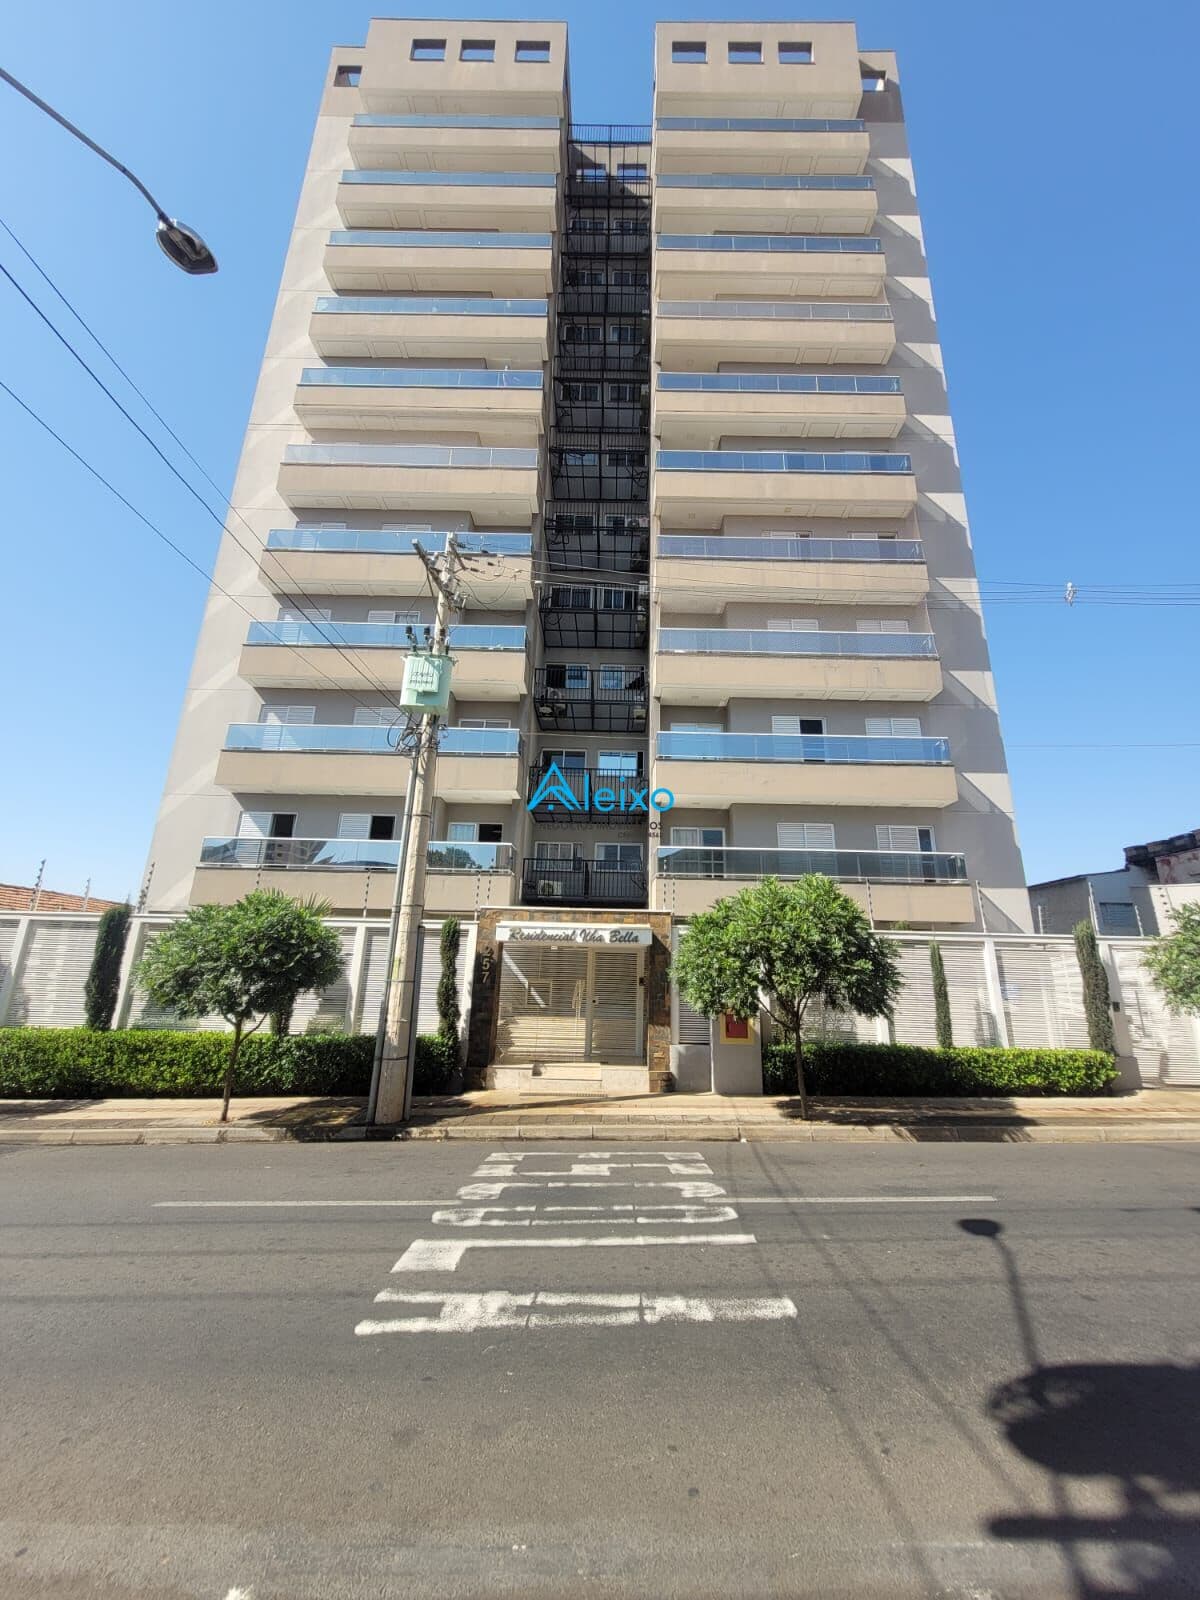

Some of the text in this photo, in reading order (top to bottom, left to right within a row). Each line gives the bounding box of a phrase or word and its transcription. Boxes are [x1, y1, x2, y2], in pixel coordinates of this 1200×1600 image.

[508, 927, 576, 942] Residencial
[609, 929, 639, 943] Bella
[481, 946, 492, 983] 257
[354, 1151, 798, 1336] ESCOLA
